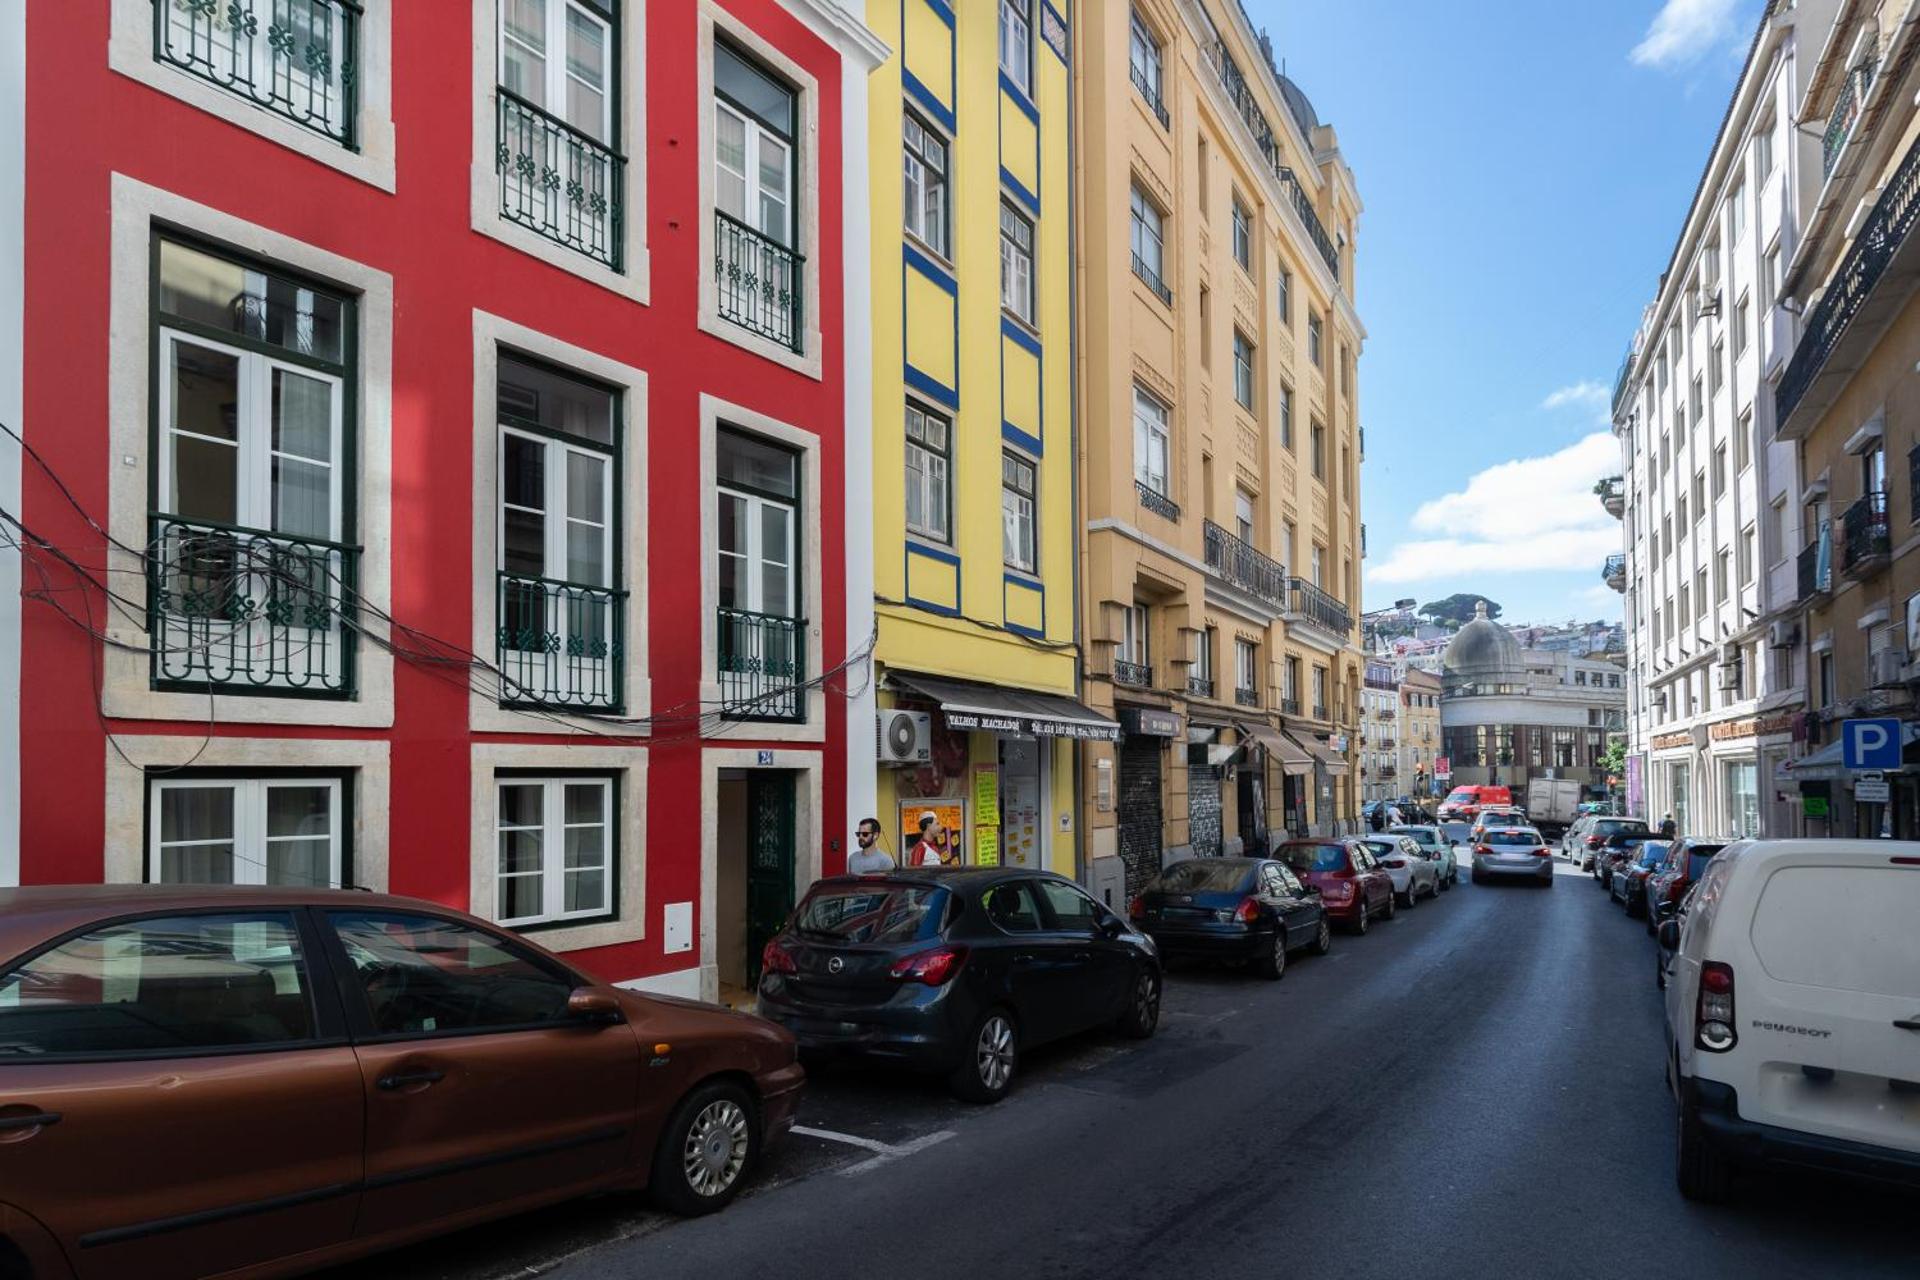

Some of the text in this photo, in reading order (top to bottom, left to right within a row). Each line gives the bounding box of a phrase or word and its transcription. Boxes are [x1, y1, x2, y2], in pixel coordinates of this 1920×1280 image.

[949, 715, 978, 727] TALHOS
[981, 718, 1019, 731] MACHADOS
[1854, 724, 1888, 765] P
[1752, 1021, 1832, 1038] PEUGEOT
